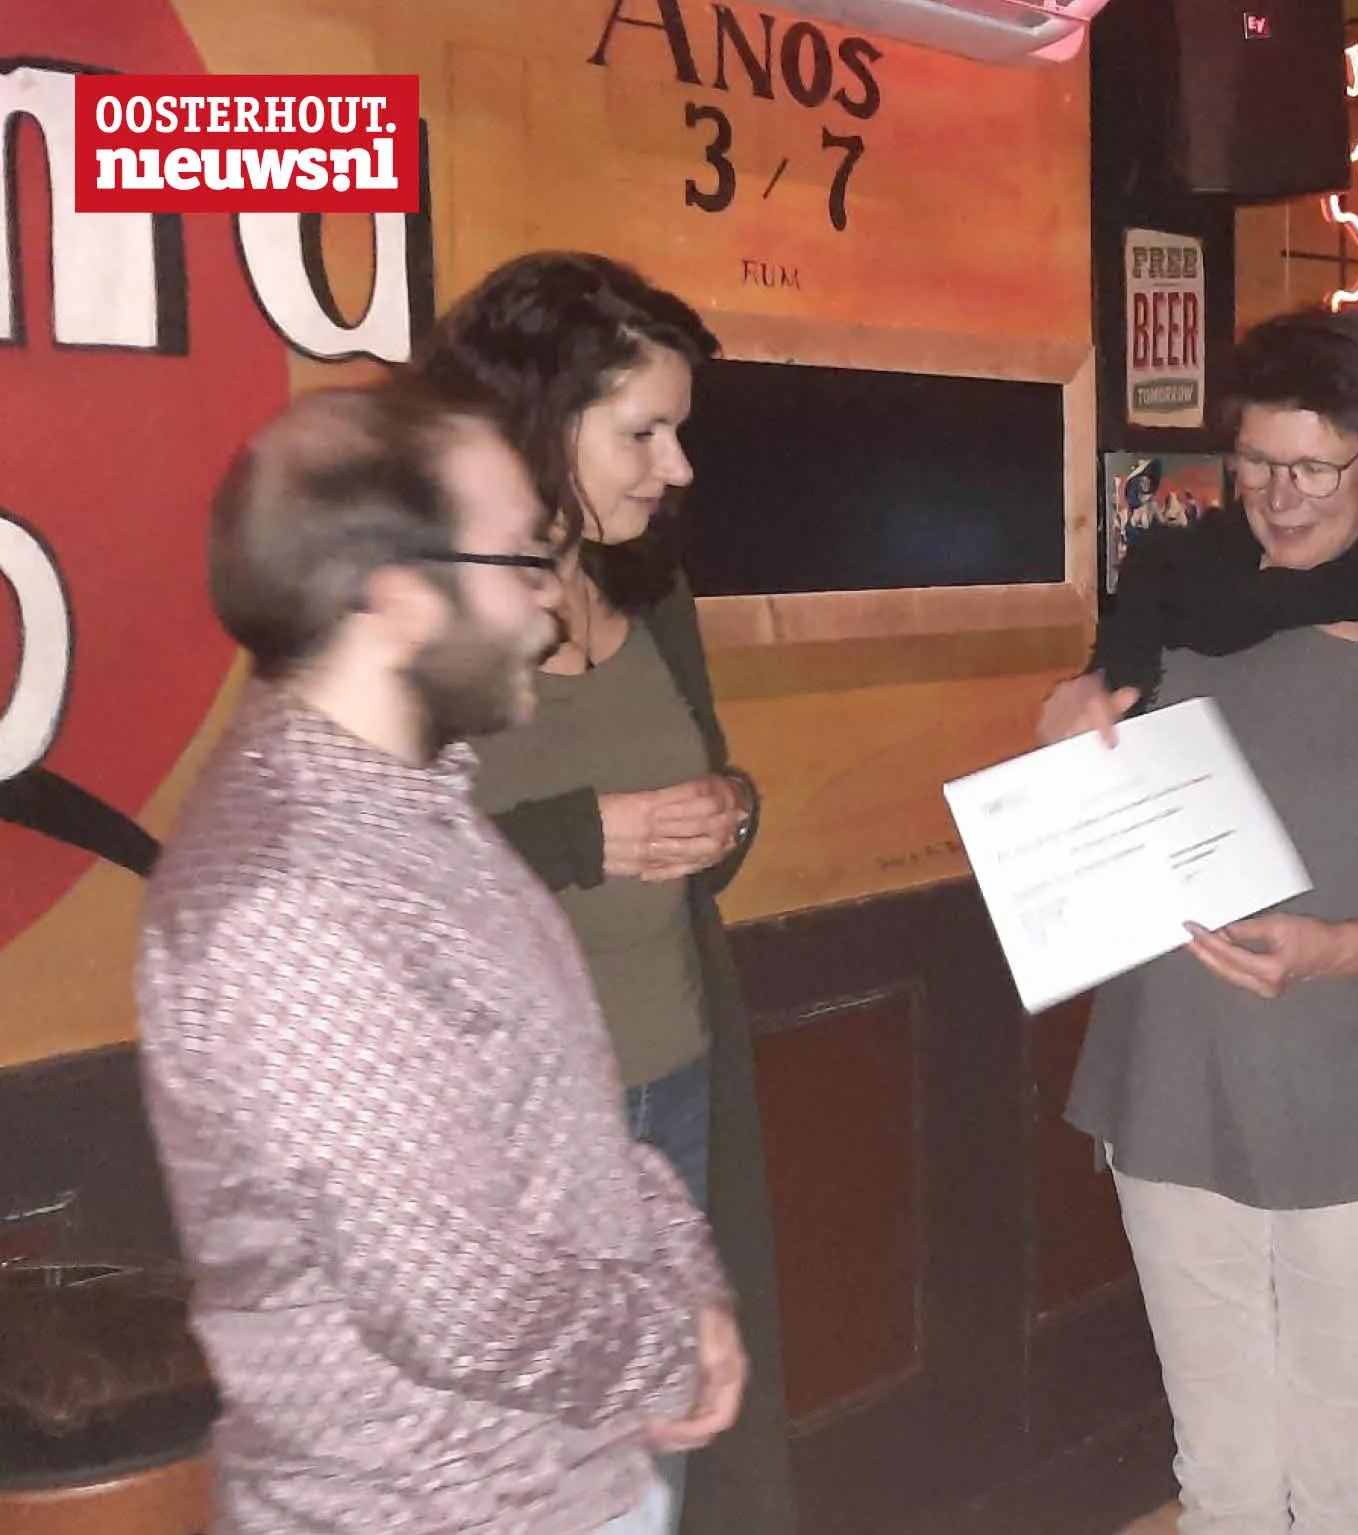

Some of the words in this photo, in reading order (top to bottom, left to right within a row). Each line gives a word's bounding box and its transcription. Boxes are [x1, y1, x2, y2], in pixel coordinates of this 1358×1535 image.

[1132, 246, 1198, 279] FREE
[1132, 291, 1198, 369] BEER
[1137, 384, 1195, 406] TOMORROW
